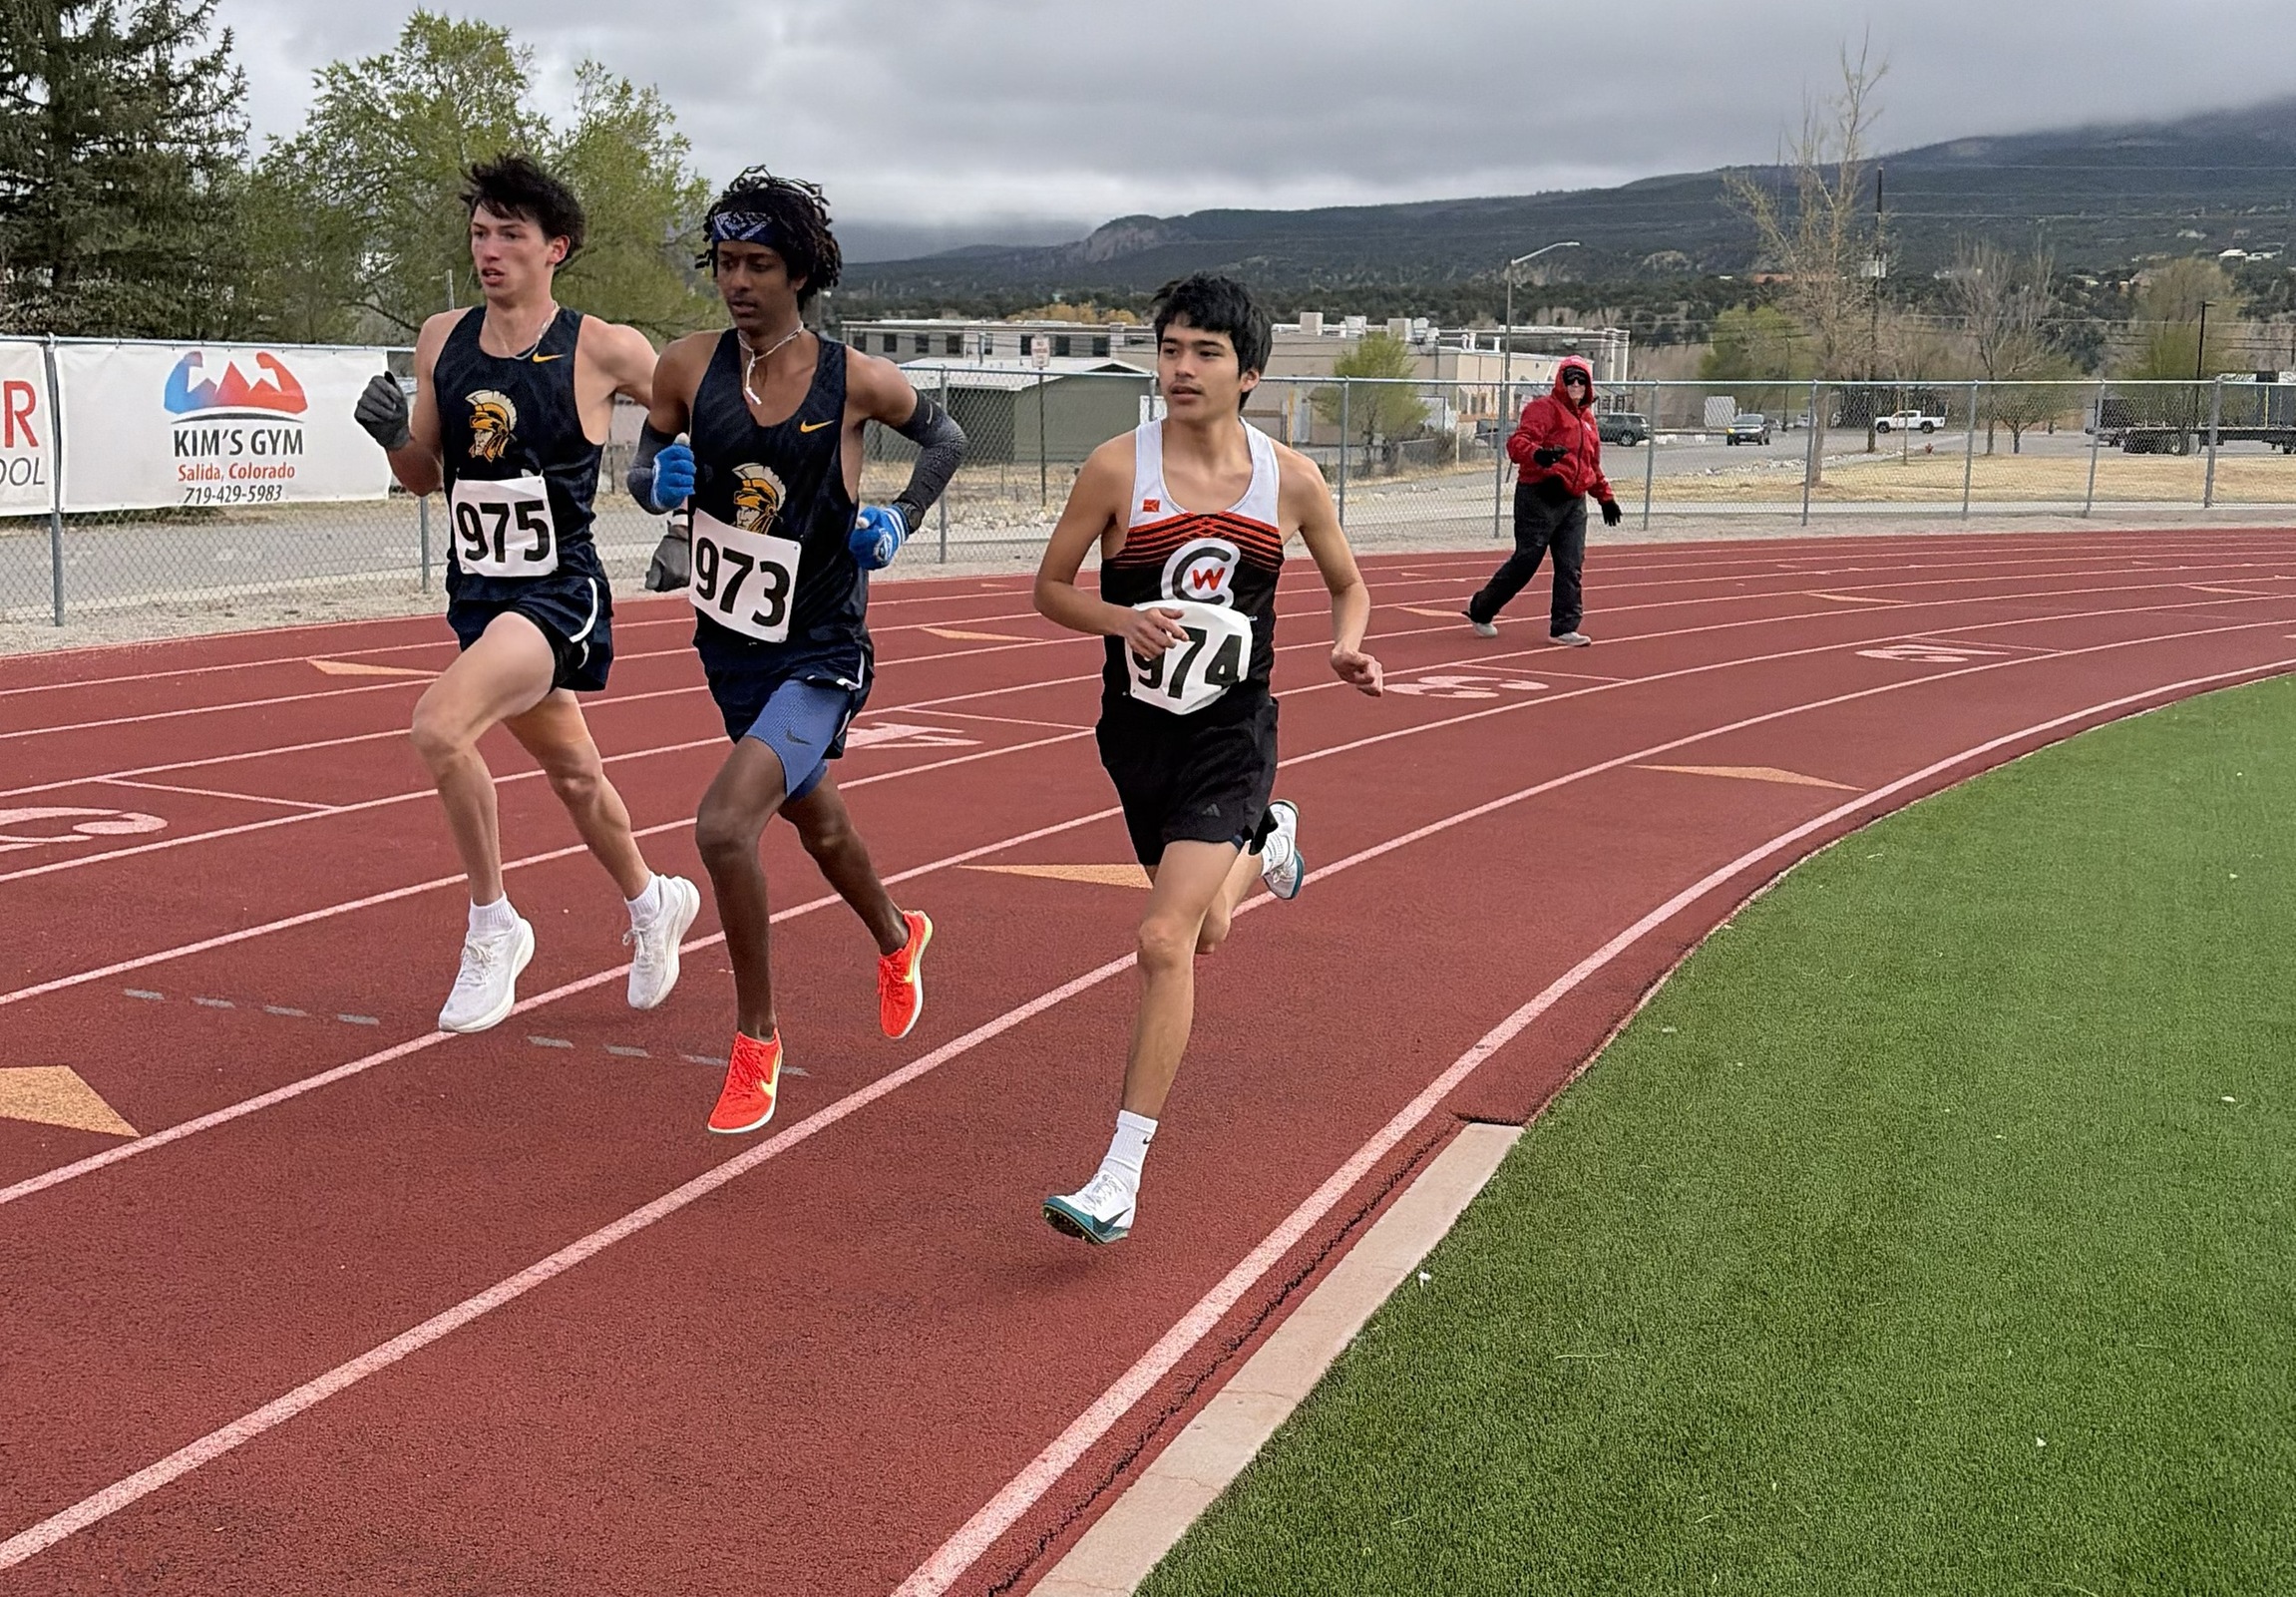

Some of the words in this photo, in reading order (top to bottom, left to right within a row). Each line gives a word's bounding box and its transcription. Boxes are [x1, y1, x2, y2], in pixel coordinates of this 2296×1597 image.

[4, 381, 39, 448] R
[174, 429, 243, 457] KIM'S
[250, 429, 303, 455] GYM
[178, 463, 224, 482] Salida,
[228, 462, 295, 479] Colorado
[184, 485, 282, 505] 719-429-5983
[455, 499, 551, 564] 975
[696, 537, 791, 627] 973
